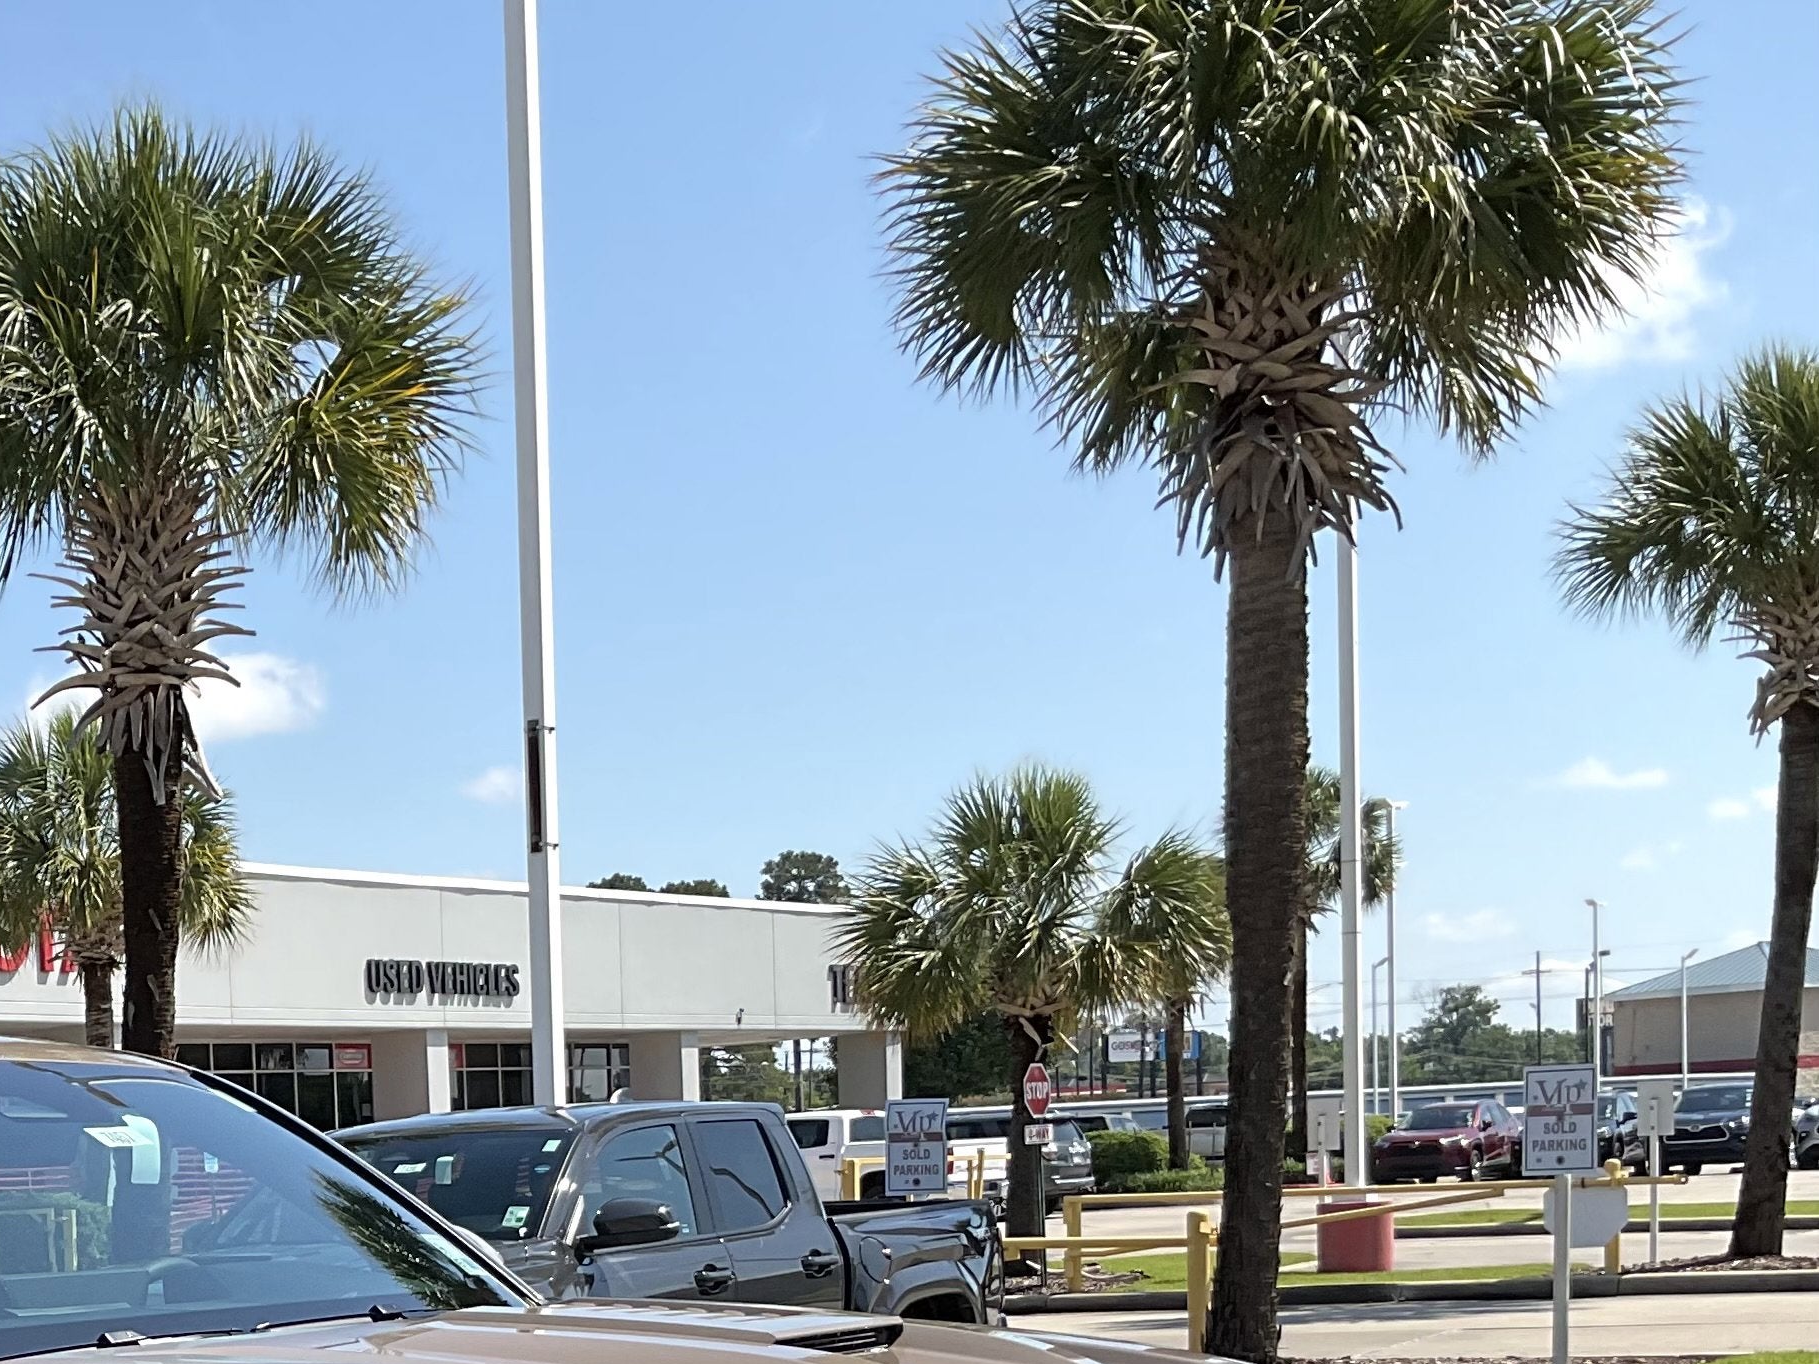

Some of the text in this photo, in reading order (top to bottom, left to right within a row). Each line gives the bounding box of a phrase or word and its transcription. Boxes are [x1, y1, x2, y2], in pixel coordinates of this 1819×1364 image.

[365, 958, 520, 997] USED VEHICLES
[1026, 1081, 1049, 1100] STOP
[1543, 1121, 1577, 1135] SOLD
[1531, 1138, 1587, 1153] PARKING
[902, 1148, 931, 1161] SOLD
[893, 1163, 940, 1177] PARKING
